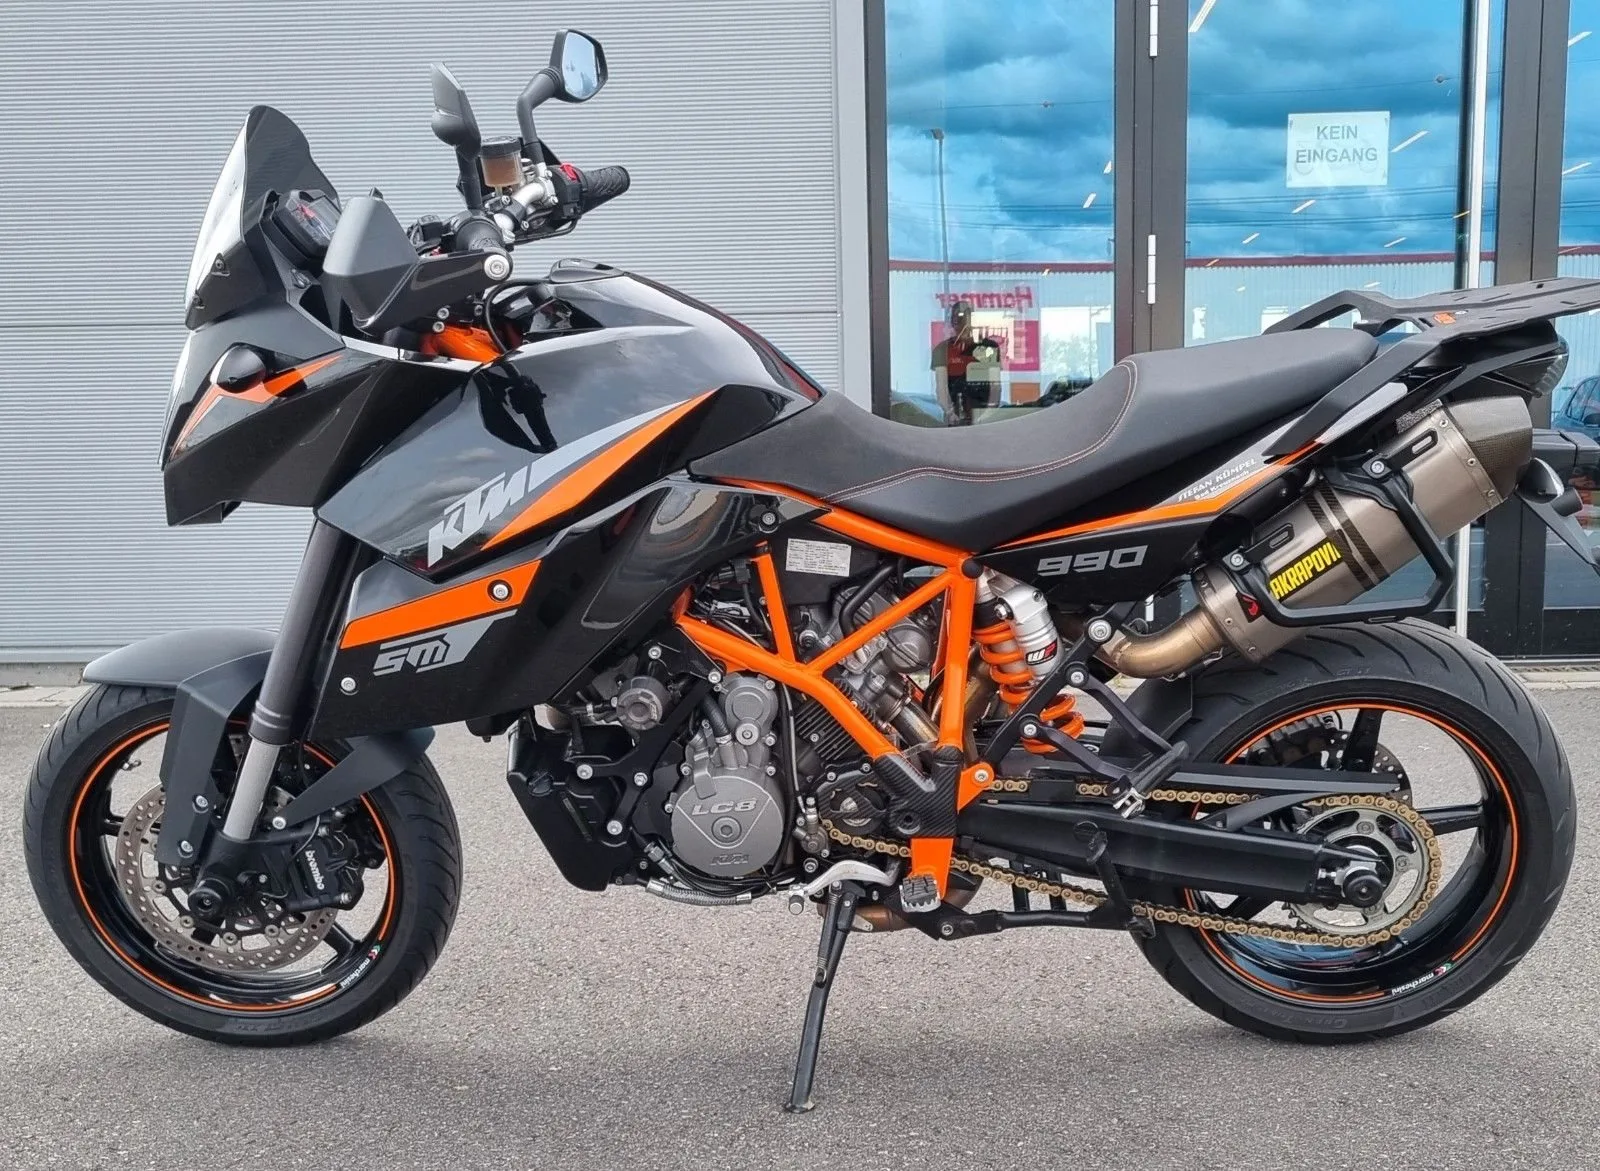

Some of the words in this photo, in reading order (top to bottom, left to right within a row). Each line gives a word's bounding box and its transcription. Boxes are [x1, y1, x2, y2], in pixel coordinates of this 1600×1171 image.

[1316, 125, 1358, 140] KEIN
[1295, 147, 1378, 163] EINGANG
[1178, 479, 1213, 502] STEFAN
[1215, 458, 1257, 483] KÜMPEL
[427, 465, 529, 568] KTM
[1036, 544, 1149, 577] 990
[1269, 542, 1342, 600] AKRAPOVI
[692, 798, 757, 816] LC8
[305, 850, 325, 890] brembo
[340, 957, 371, 989] marchesini
[1391, 972, 1435, 996] marchesini
